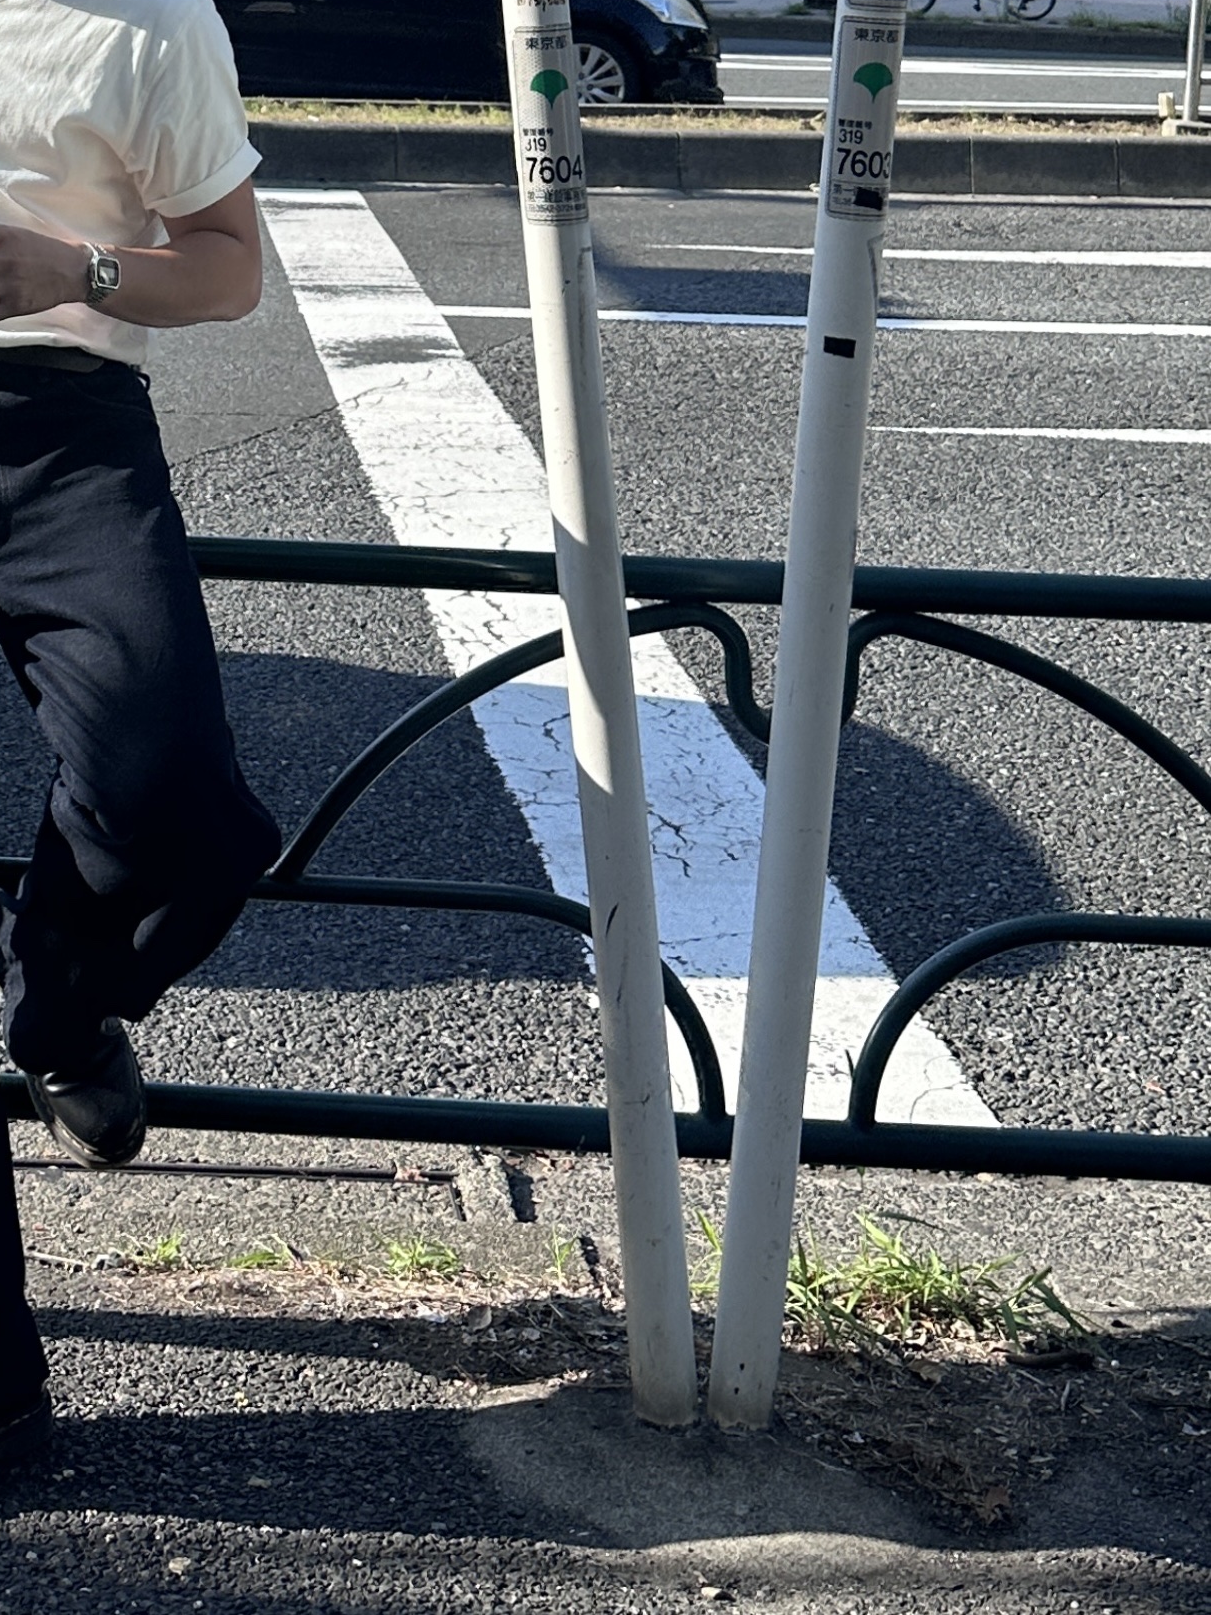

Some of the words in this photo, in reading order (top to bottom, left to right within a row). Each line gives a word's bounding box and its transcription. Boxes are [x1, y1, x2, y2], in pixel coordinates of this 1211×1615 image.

[525, 36, 567, 51] 東京都
[854, 27, 900, 44] 東京都
[838, 130, 864, 145] 319
[525, 154, 584, 184] 7604
